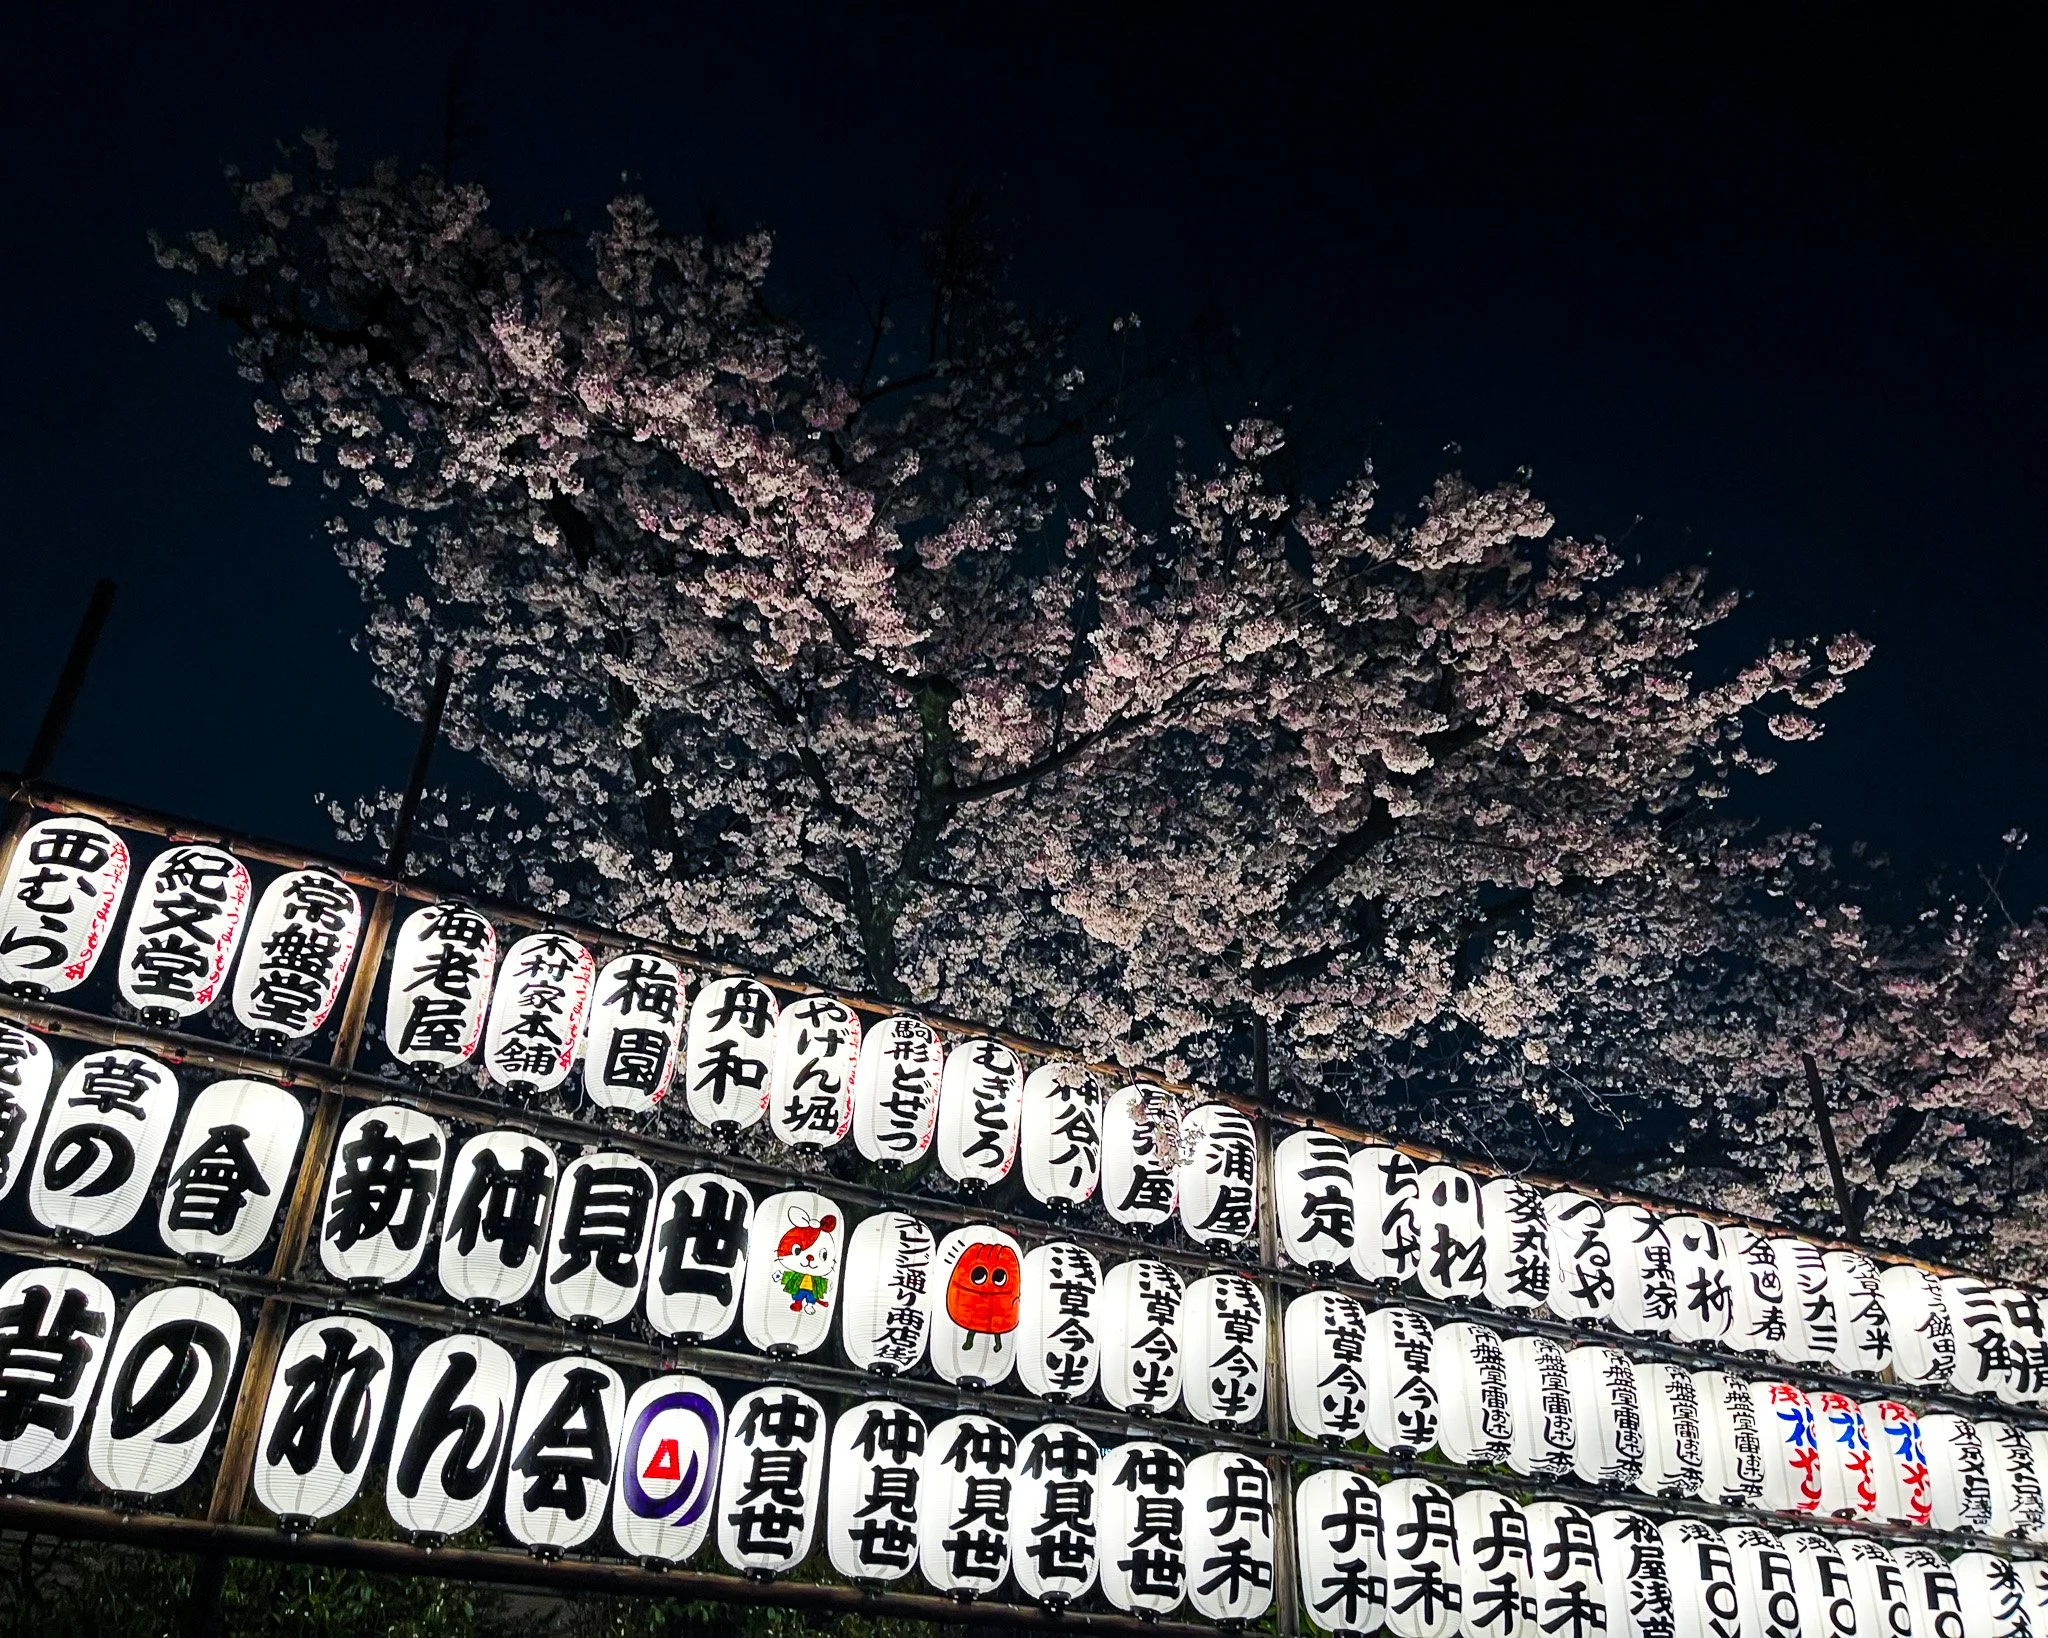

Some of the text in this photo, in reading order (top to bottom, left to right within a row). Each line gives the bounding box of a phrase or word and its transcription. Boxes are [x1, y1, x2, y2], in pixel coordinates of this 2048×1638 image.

[1, 828, 109, 970] 西むら
[131, 849, 235, 1001] 紀文堂
[248, 875, 354, 1031] 常盤堂
[398, 902, 489, 1054] 海老屋
[494, 937, 578, 1075] 木村家本舗
[602, 958, 678, 1097] 梅園
[693, 981, 775, 1104] 舟和
[781, 1000, 849, 1134] やげん堀
[877, 1020, 933, 1151] 駒形どぜう
[962, 1043, 1017, 1168] むぎとろ
[1195, 1111, 1256, 1238] 三浦屋
[1297, 1137, 1354, 1248] 三定
[1378, 1154, 1420, 1273] ちんや
[1430, 1177, 1486, 1290] 小松
[872, 1217, 931, 1367] オレンジ通り商店街
[1046, 1246, 1097, 1390] 浅草今半
[1558, 1199, 1614, 1308] つるや
[1632, 1216, 1677, 1320] 大黒家
[1842, 1255, 1893, 1361] 浅草今半
[1131, 1263, 1182, 1402] 浅草今半
[1209, 1277, 1262, 1417] 浅草今半
[1317, 1296, 1367, 1432] 浅草今半
[1390, 1311, 1439, 1444] 浅草今半
[728, 1394, 818, 1559] 仲見世
[848, 1409, 925, 1570] 仲見世
[940, 1422, 1016, 1582] 仲見世
[1021, 1432, 1099, 1583] 仲見世
[1112, 1449, 1187, 1599] 仲見世
[1197, 1458, 1273, 1604] 舟和
[1312, 1476, 1387, 1624] 舟和
[1391, 1486, 1462, 1625] 舟和
[1471, 1498, 1537, 1636] 舟和
[1540, 1506, 1607, 1638] 舟和
[1816, 1556, 1856, 1638] RO
[1876, 1565, 1912, 1638] RO
